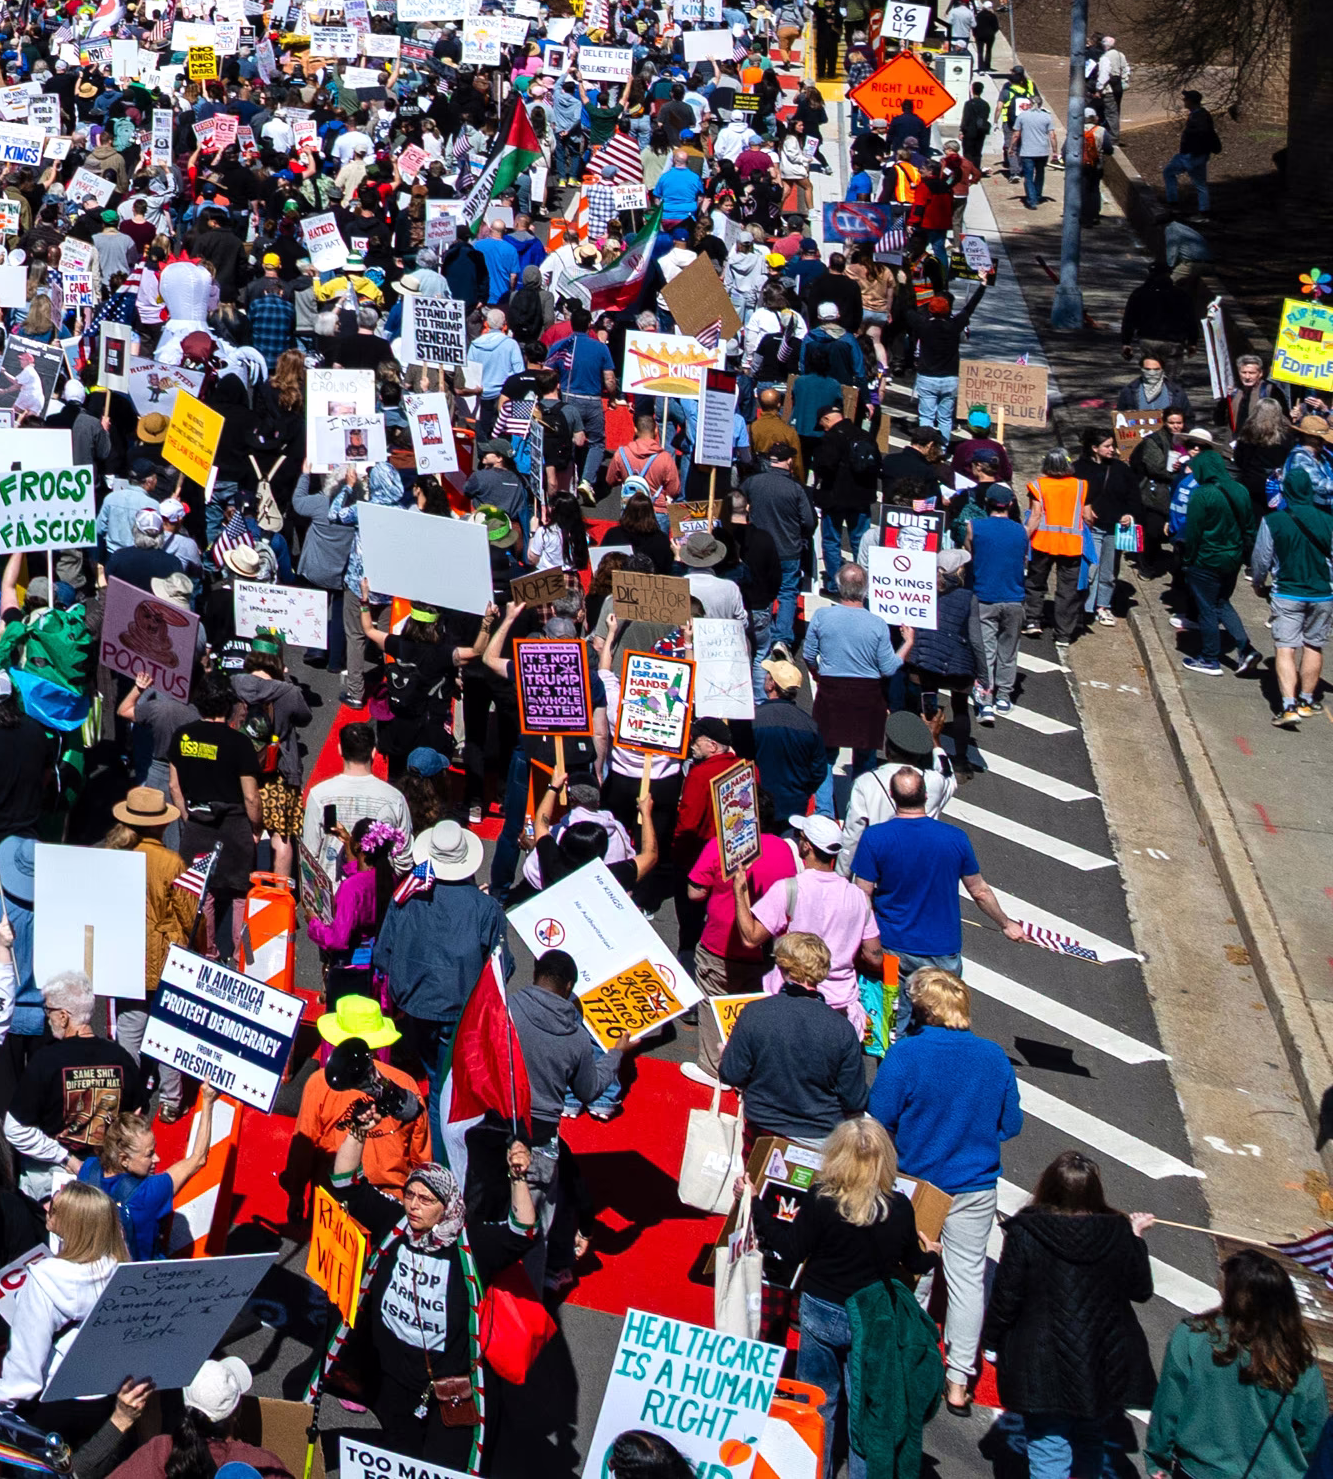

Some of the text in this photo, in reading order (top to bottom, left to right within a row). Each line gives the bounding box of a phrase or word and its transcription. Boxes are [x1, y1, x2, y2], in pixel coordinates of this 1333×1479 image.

[890, 2, 916, 21] 86
[893, 20, 917, 38] 47
[190, 52, 214, 62] KINGS
[582, 49, 631, 60] DELETE ICE
[581, 64, 631, 75] RELEASE FILES
[870, 82, 935, 97] RIGHT LANE
[967, 367, 981, 377] IN
[966, 378, 1036, 393] DUMP TRUMP
[965, 390, 1032, 405] FIRE THE GOP
[0, 468, 92, 507] FROGS
[887, 511, 939, 530] QUIET
[0, 518, 96, 551] FASCISM
[872, 577, 933, 590] NO KINGS
[874, 590, 931, 604] NO WAR
[878, 604, 927, 618] NO ICE
[523, 654, 574, 665] IT'S NOT
[524, 664, 556, 675] JUST
[524, 674, 580, 685] TRUMP
[526, 685, 580, 697] IT'S THE
[538, 696, 582, 706] WHOLE
[528, 705, 583, 716] SYSTEM
[197, 964, 265, 1007] IN AMERICA
[196, 981, 261, 1014] WE SHOULD NOT HAVE TO
[160, 991, 283, 1058] PROTECT DEMOCRACY
[196, 1042, 222, 1062] FROM THE
[73, 1069, 93, 1078] SAME
[172, 1048, 236, 1090] PRESIDENT!
[66, 1078, 104, 1088] DIFFERENT
[397, 1262, 442, 1288] STOP
[380, 1299, 445, 1333] ISRAEL
[624, 1313, 780, 1377] HEALTHCARE
[616, 1349, 773, 1414] IS A HUMAN
[641, 1390, 738, 1440] RIGHT
